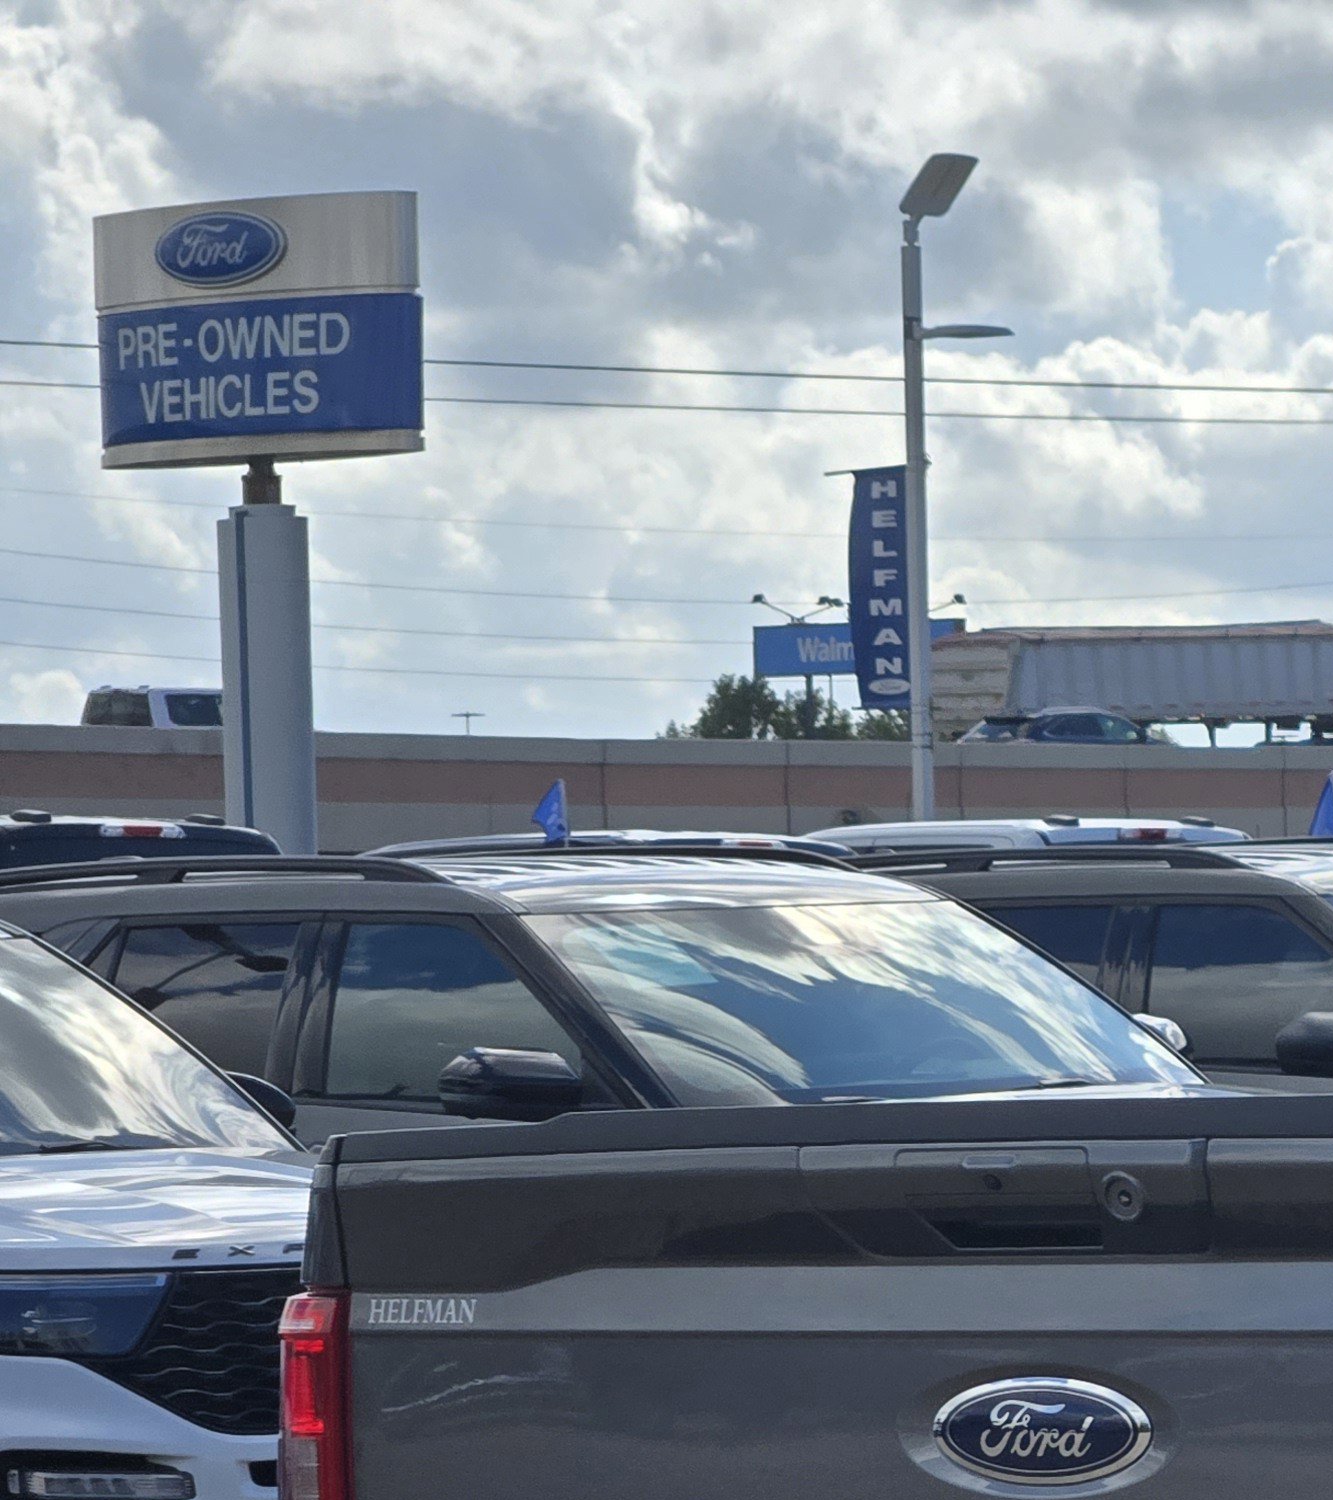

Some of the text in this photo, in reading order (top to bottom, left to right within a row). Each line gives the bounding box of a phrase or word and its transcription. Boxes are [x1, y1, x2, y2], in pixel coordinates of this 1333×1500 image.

[176, 222, 248, 268] Ford
[117, 312, 350, 370] PRE-OWNED
[139, 370, 320, 424] VEHICLES
[868, 479, 903, 675] HELFMAN
[797, 636, 856, 663] Walm
[368, 1298, 477, 1325] HELFMAN
[979, 1399, 1095, 1458] Ford
